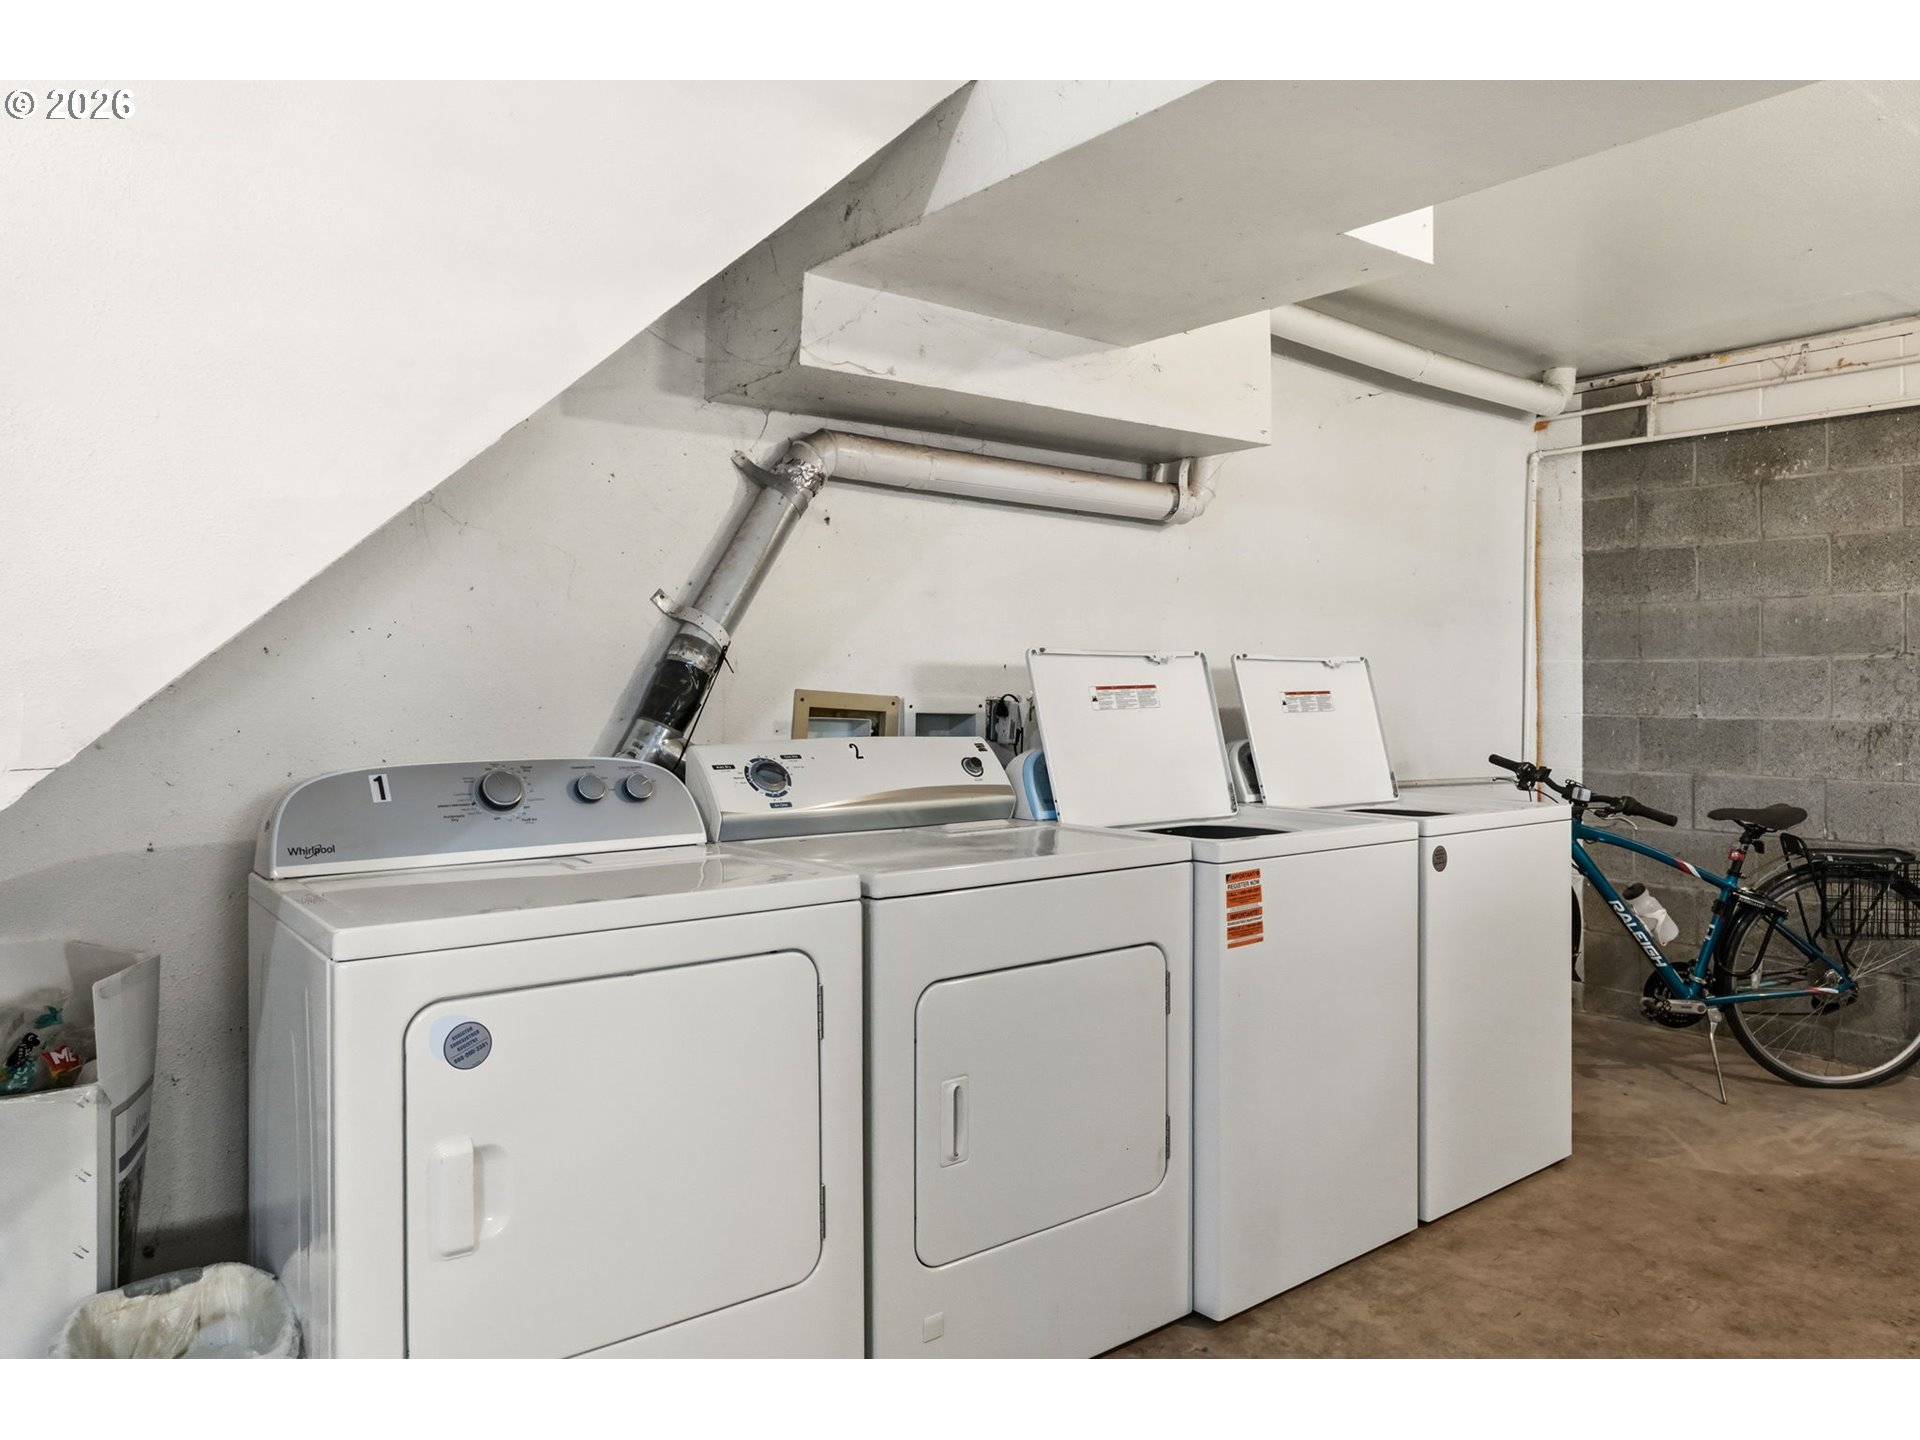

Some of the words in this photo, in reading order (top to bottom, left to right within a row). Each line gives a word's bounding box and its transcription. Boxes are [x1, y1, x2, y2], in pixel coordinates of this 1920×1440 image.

[849, 743, 864, 759] 2
[373, 775, 386, 801] 1
[287, 844, 336, 859] Whirlpool
[1227, 882, 1249, 890] REGISTER
[1608, 900, 1667, 968] RALEIGH
